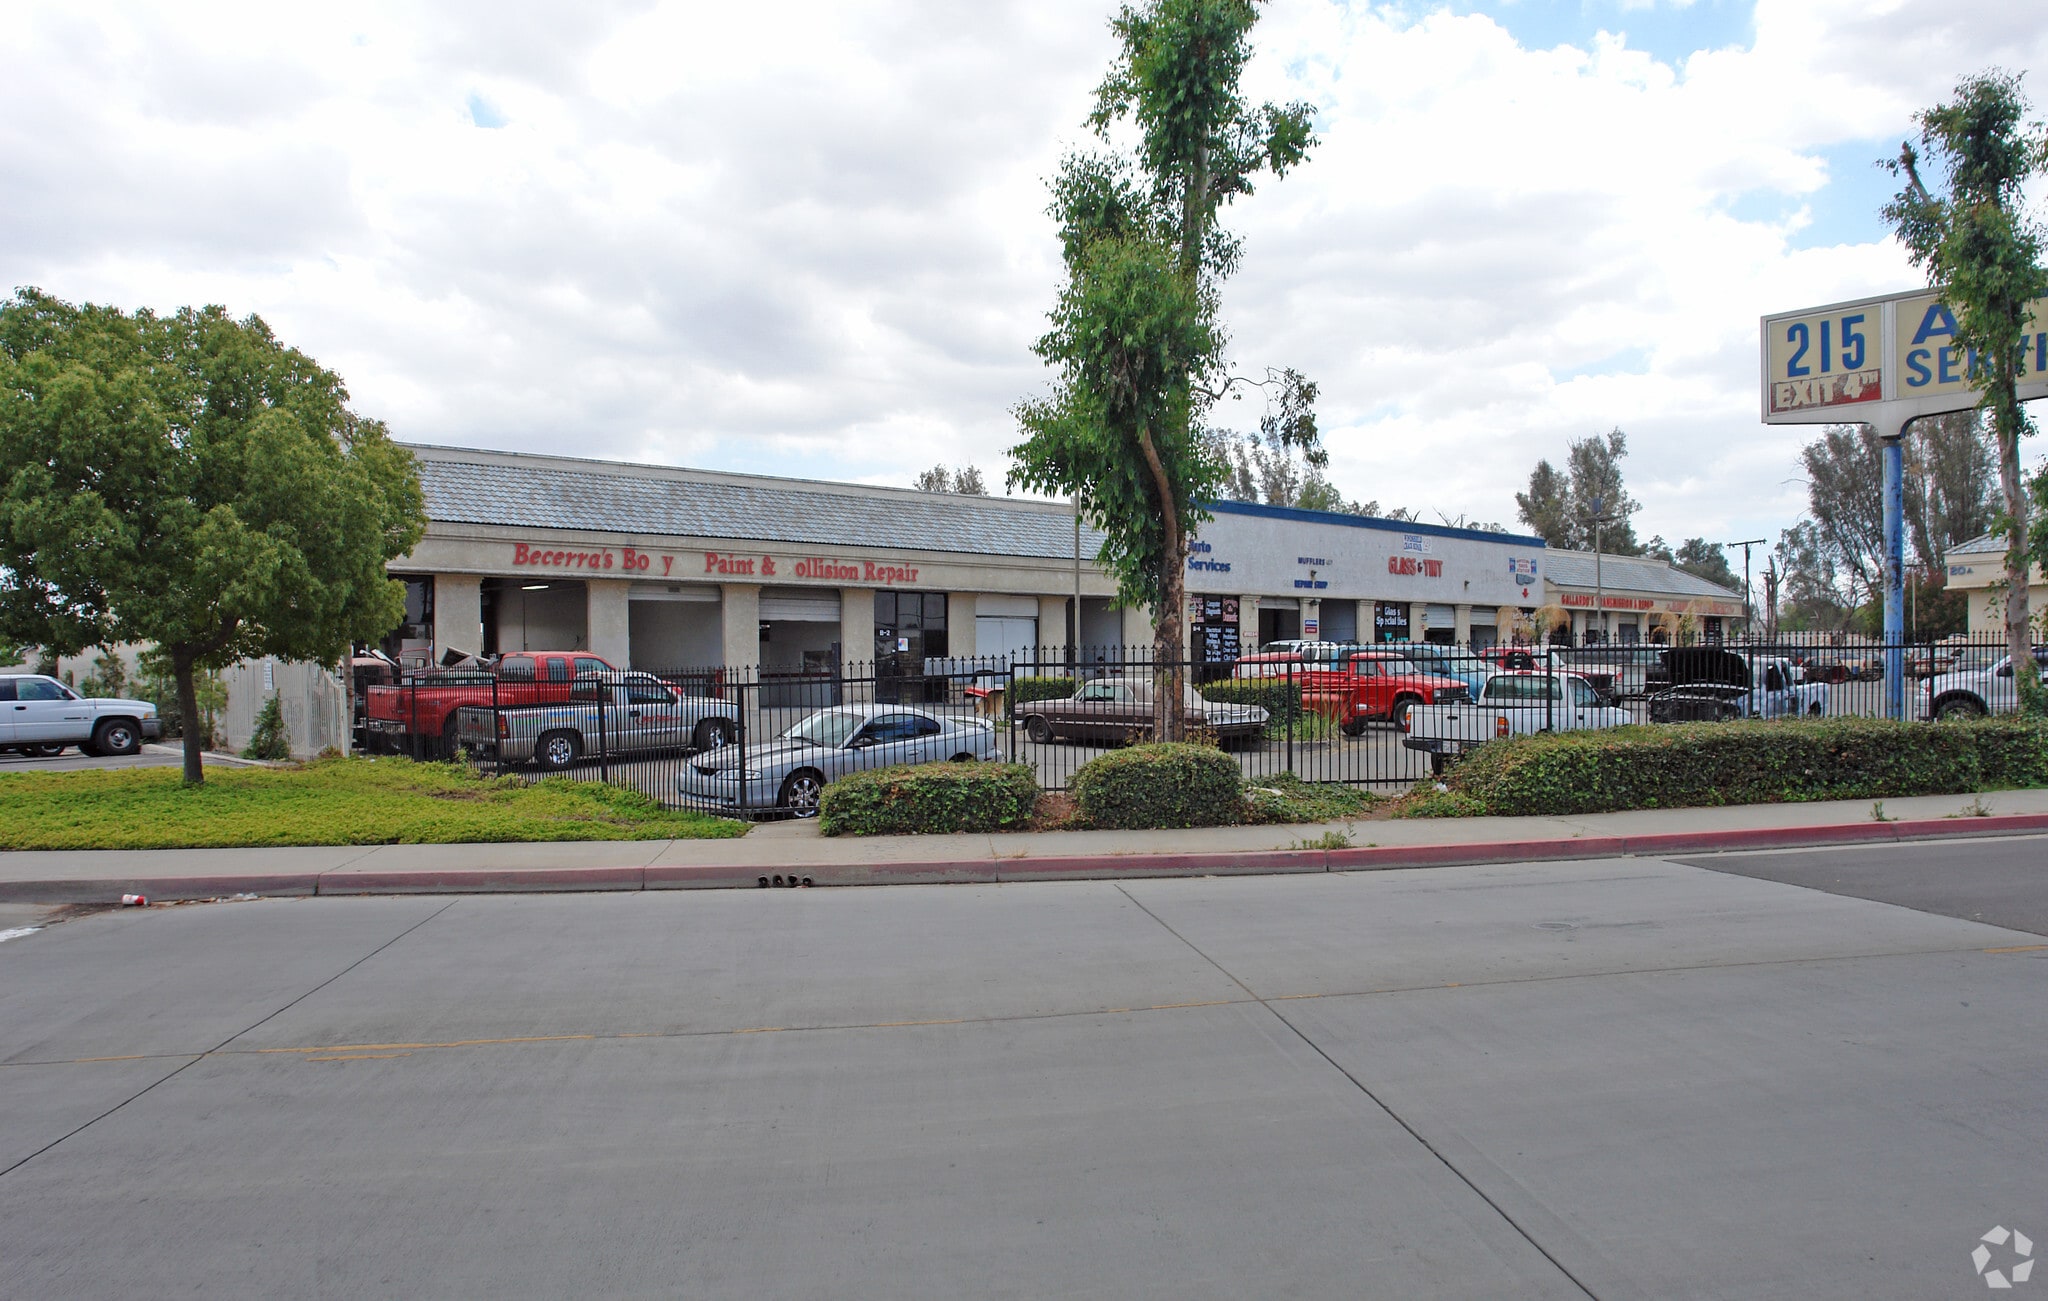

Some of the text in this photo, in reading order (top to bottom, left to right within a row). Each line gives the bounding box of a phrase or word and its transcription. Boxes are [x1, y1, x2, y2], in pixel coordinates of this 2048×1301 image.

[1787, 314, 1865, 378] 215
[1776, 377, 1838, 409] EXIT
[512, 542, 614, 570] Becerra's
[704, 551, 755, 576] Paint
[760, 554, 776, 576] &
[863, 560, 920, 585] Repair
[1188, 555, 1231, 573] Services
[1388, 555, 1417, 577] GLASS
[1423, 559, 1443, 577] TINT
